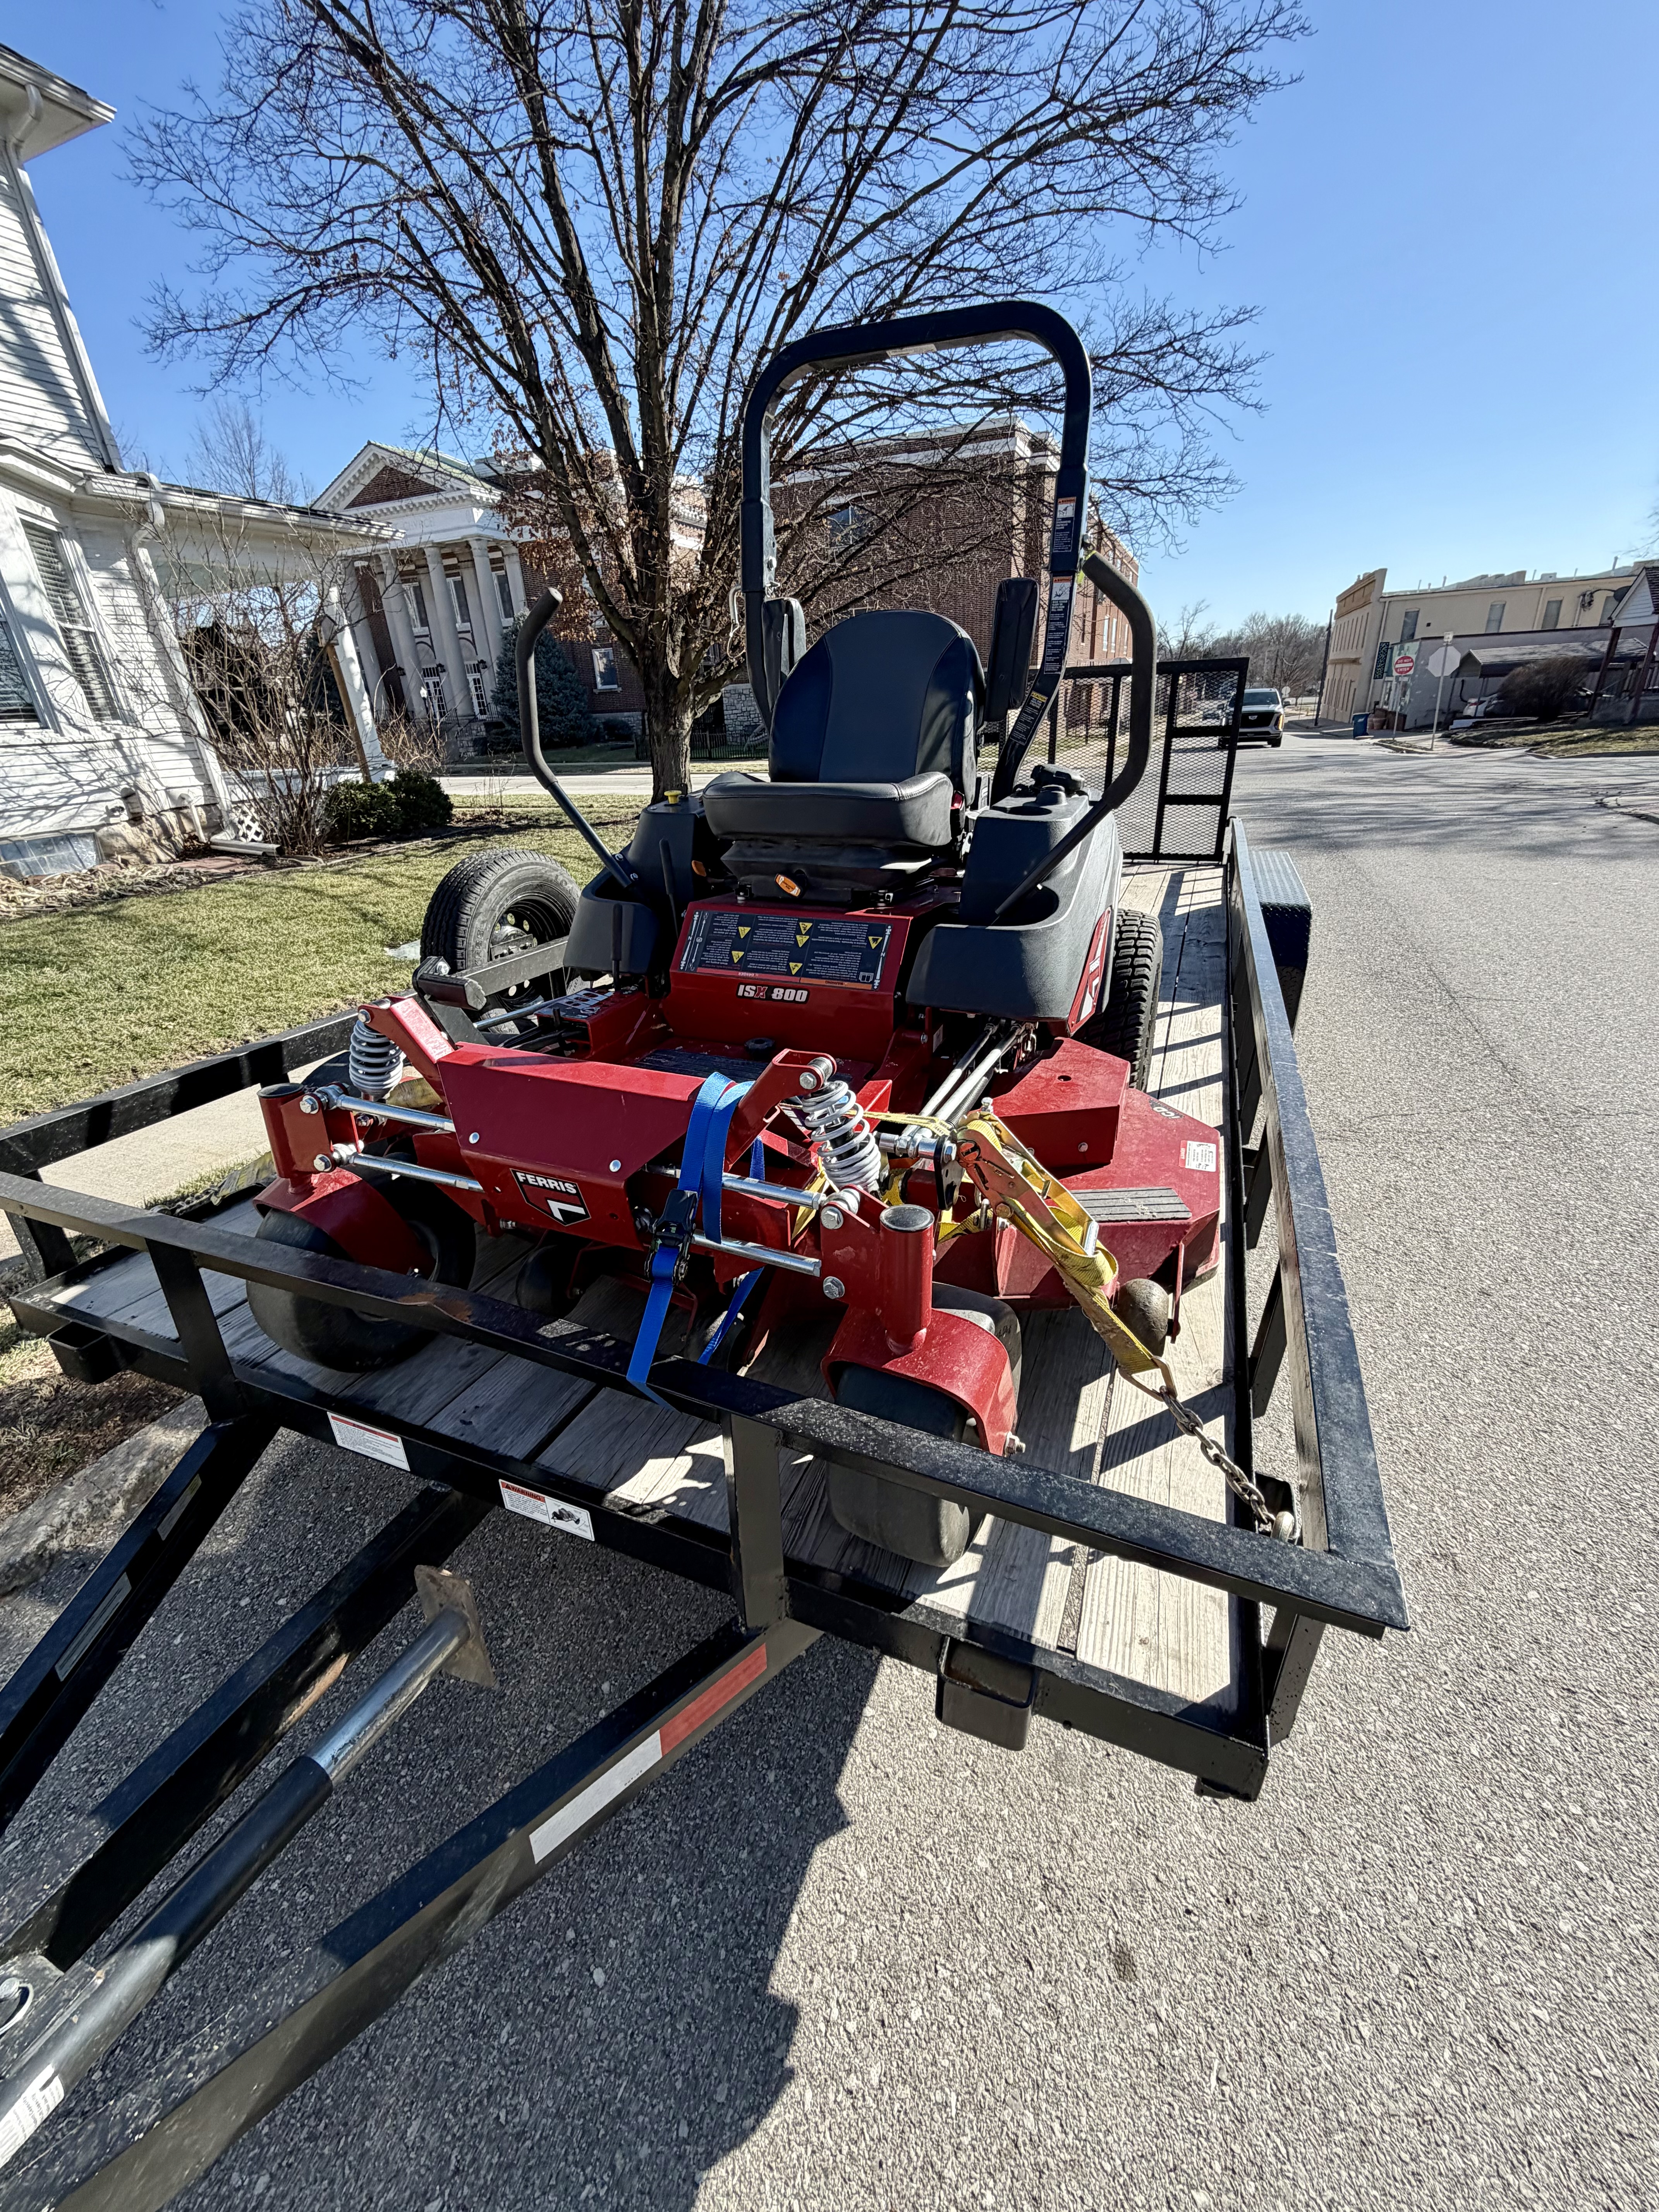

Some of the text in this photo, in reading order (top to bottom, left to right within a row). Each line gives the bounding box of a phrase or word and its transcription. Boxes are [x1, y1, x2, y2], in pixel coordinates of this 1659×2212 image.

[738, 984, 808, 1002] ISX 800
[516, 1172, 577, 1194] FERRIS
[510, 1485, 541, 1501] WARNING
